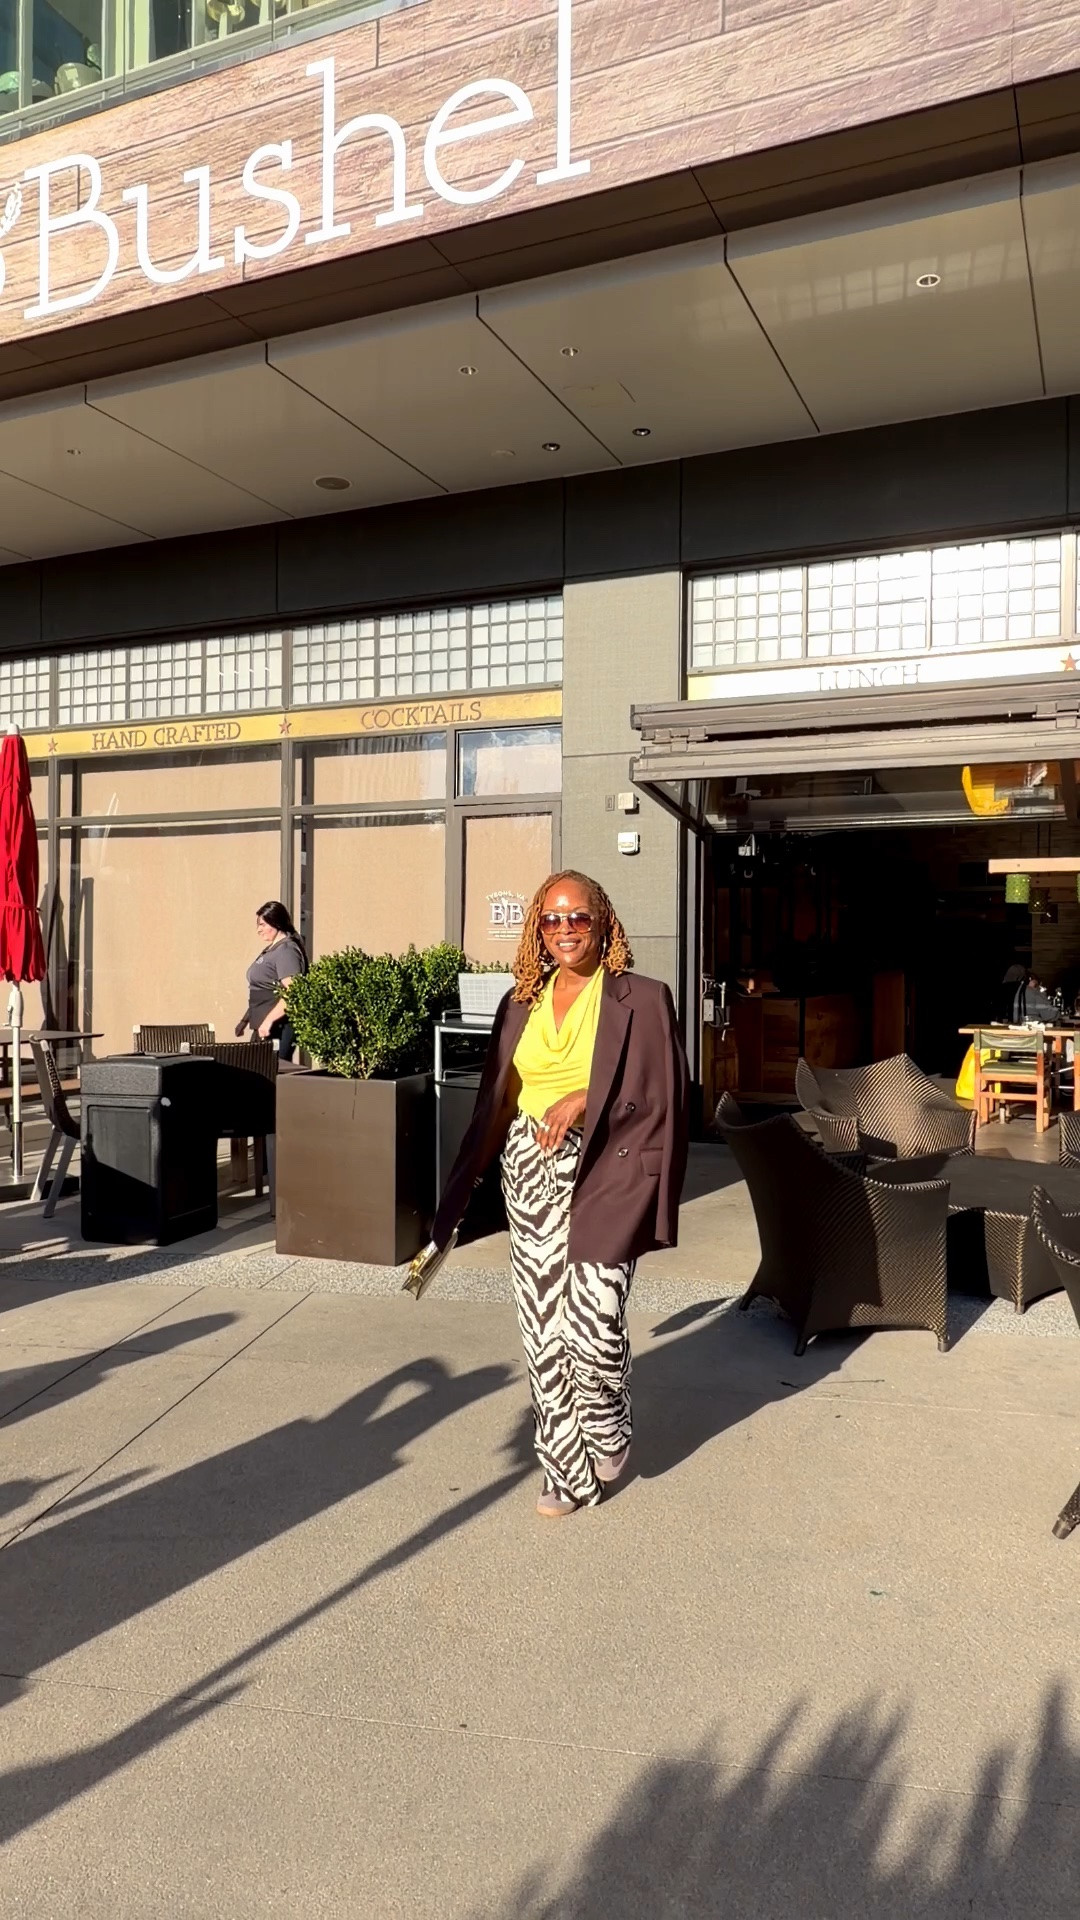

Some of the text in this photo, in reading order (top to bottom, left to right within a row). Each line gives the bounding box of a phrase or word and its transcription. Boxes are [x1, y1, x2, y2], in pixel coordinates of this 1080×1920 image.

[24, 0, 591, 319] Bushel
[816, 663, 921, 691] LUNCH
[361, 701, 482, 730] COCKTAILS
[92, 721, 241, 750] HAND CRAFTED
